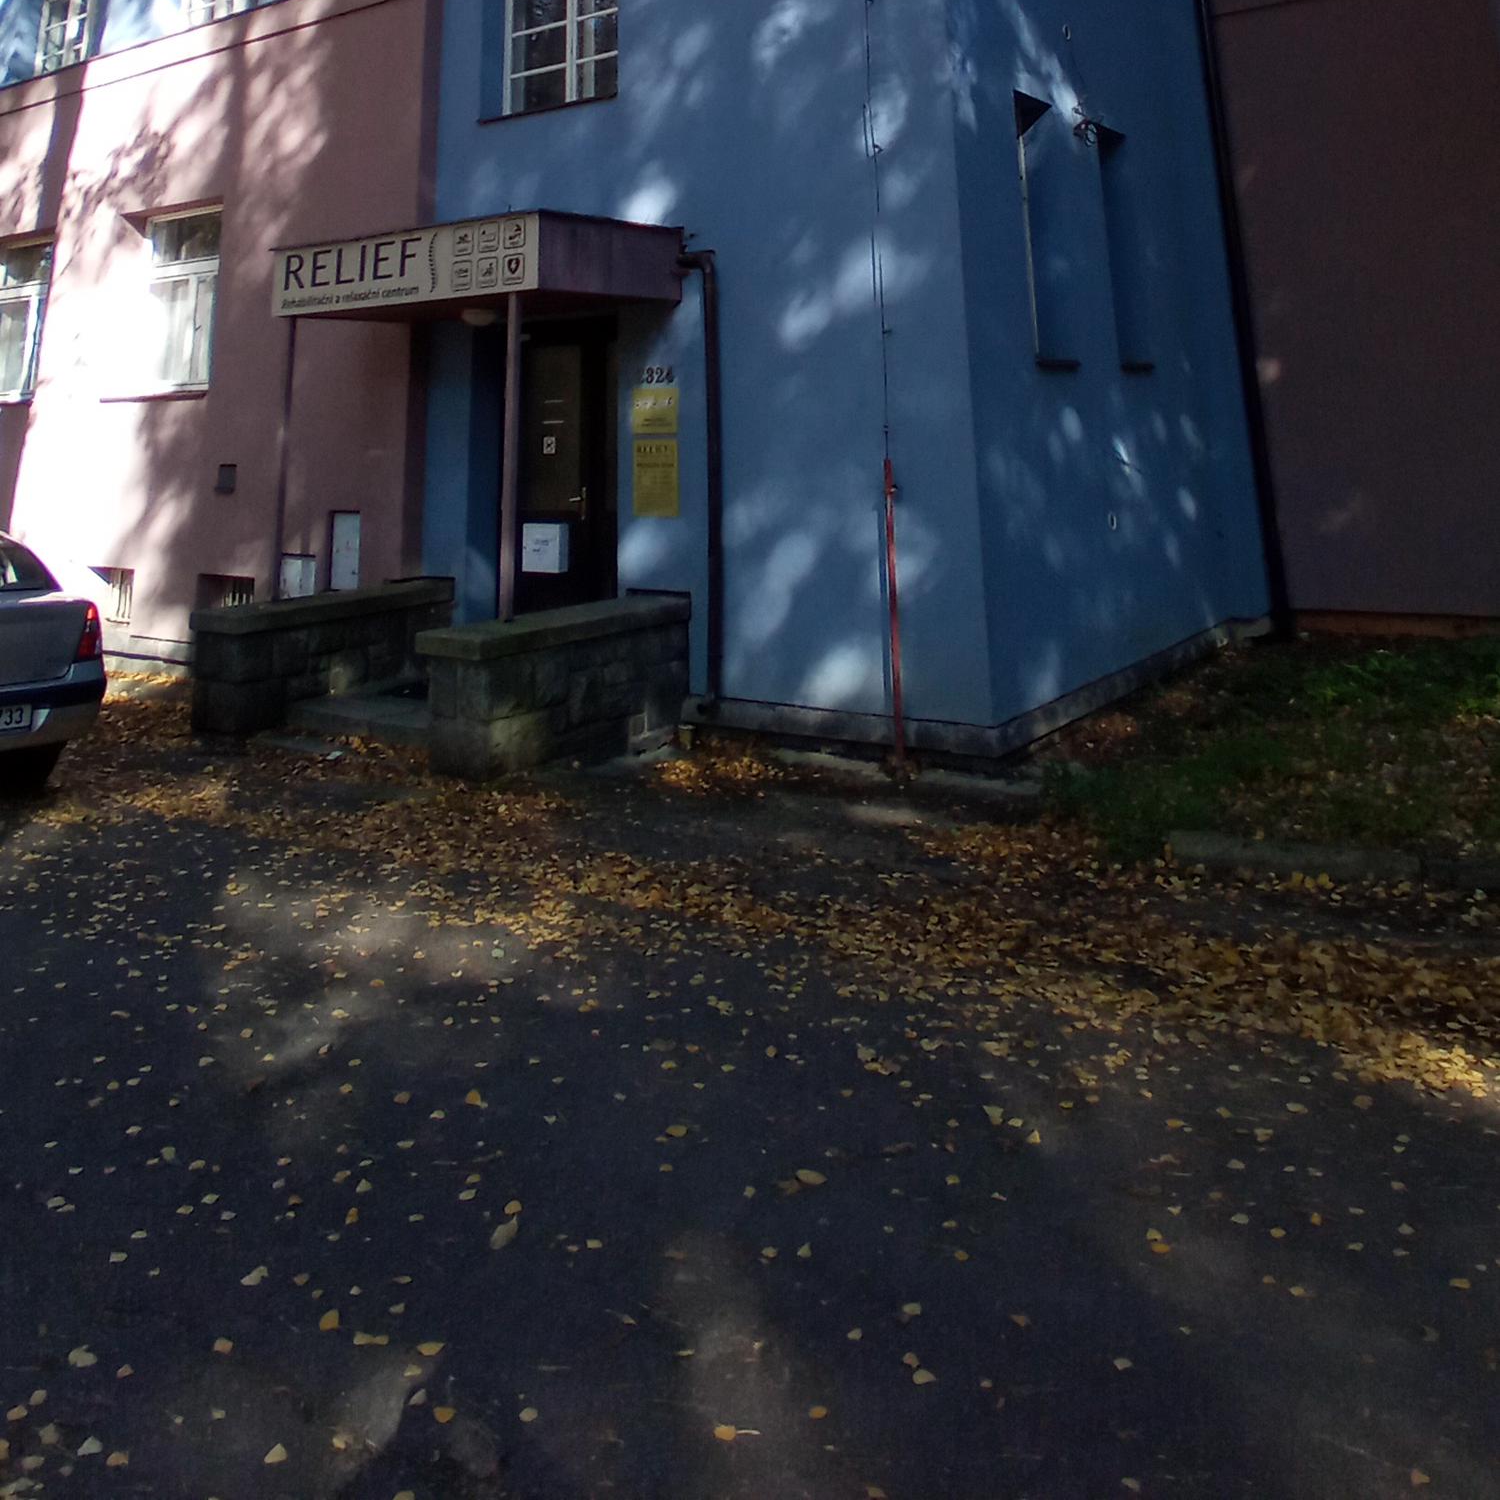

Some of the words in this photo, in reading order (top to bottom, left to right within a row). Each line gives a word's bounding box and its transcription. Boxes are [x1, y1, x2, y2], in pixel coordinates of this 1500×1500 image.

[284, 237, 422, 291] RELIEF
[335, 295, 341, 304] a
[381, 285, 420, 299] centrum
